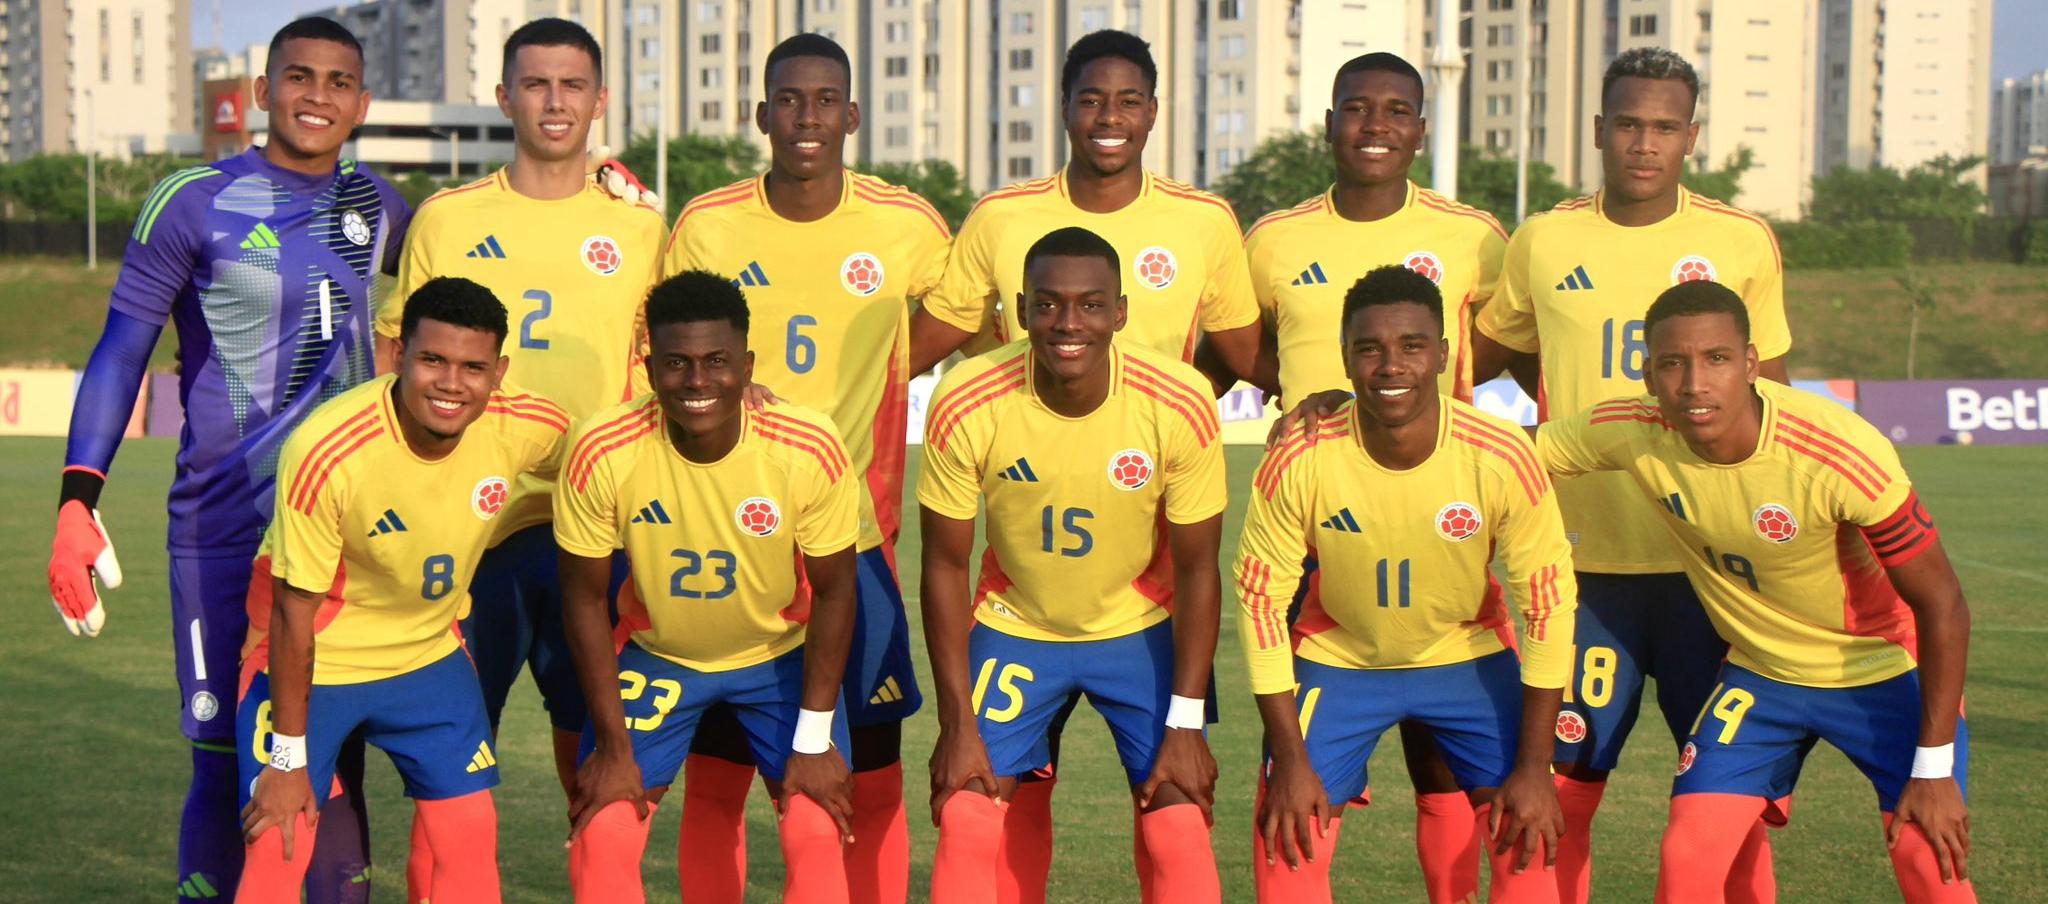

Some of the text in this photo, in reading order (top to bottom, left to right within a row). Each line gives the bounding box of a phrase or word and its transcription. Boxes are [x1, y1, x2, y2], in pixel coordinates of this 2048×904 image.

[319, 279, 333, 340] 1
[520, 289, 552, 350] 2
[786, 314, 817, 374] 6
[1602, 318, 1649, 380] 18
[1042, 505, 1094, 558] 15
[421, 553, 455, 601] 8
[670, 548, 737, 599] 23
[1376, 558, 1411, 608] 11
[1703, 546, 1760, 593] 19
[190, 618, 207, 680] 1
[618, 669, 682, 732] 23
[971, 657, 1034, 723] 15
